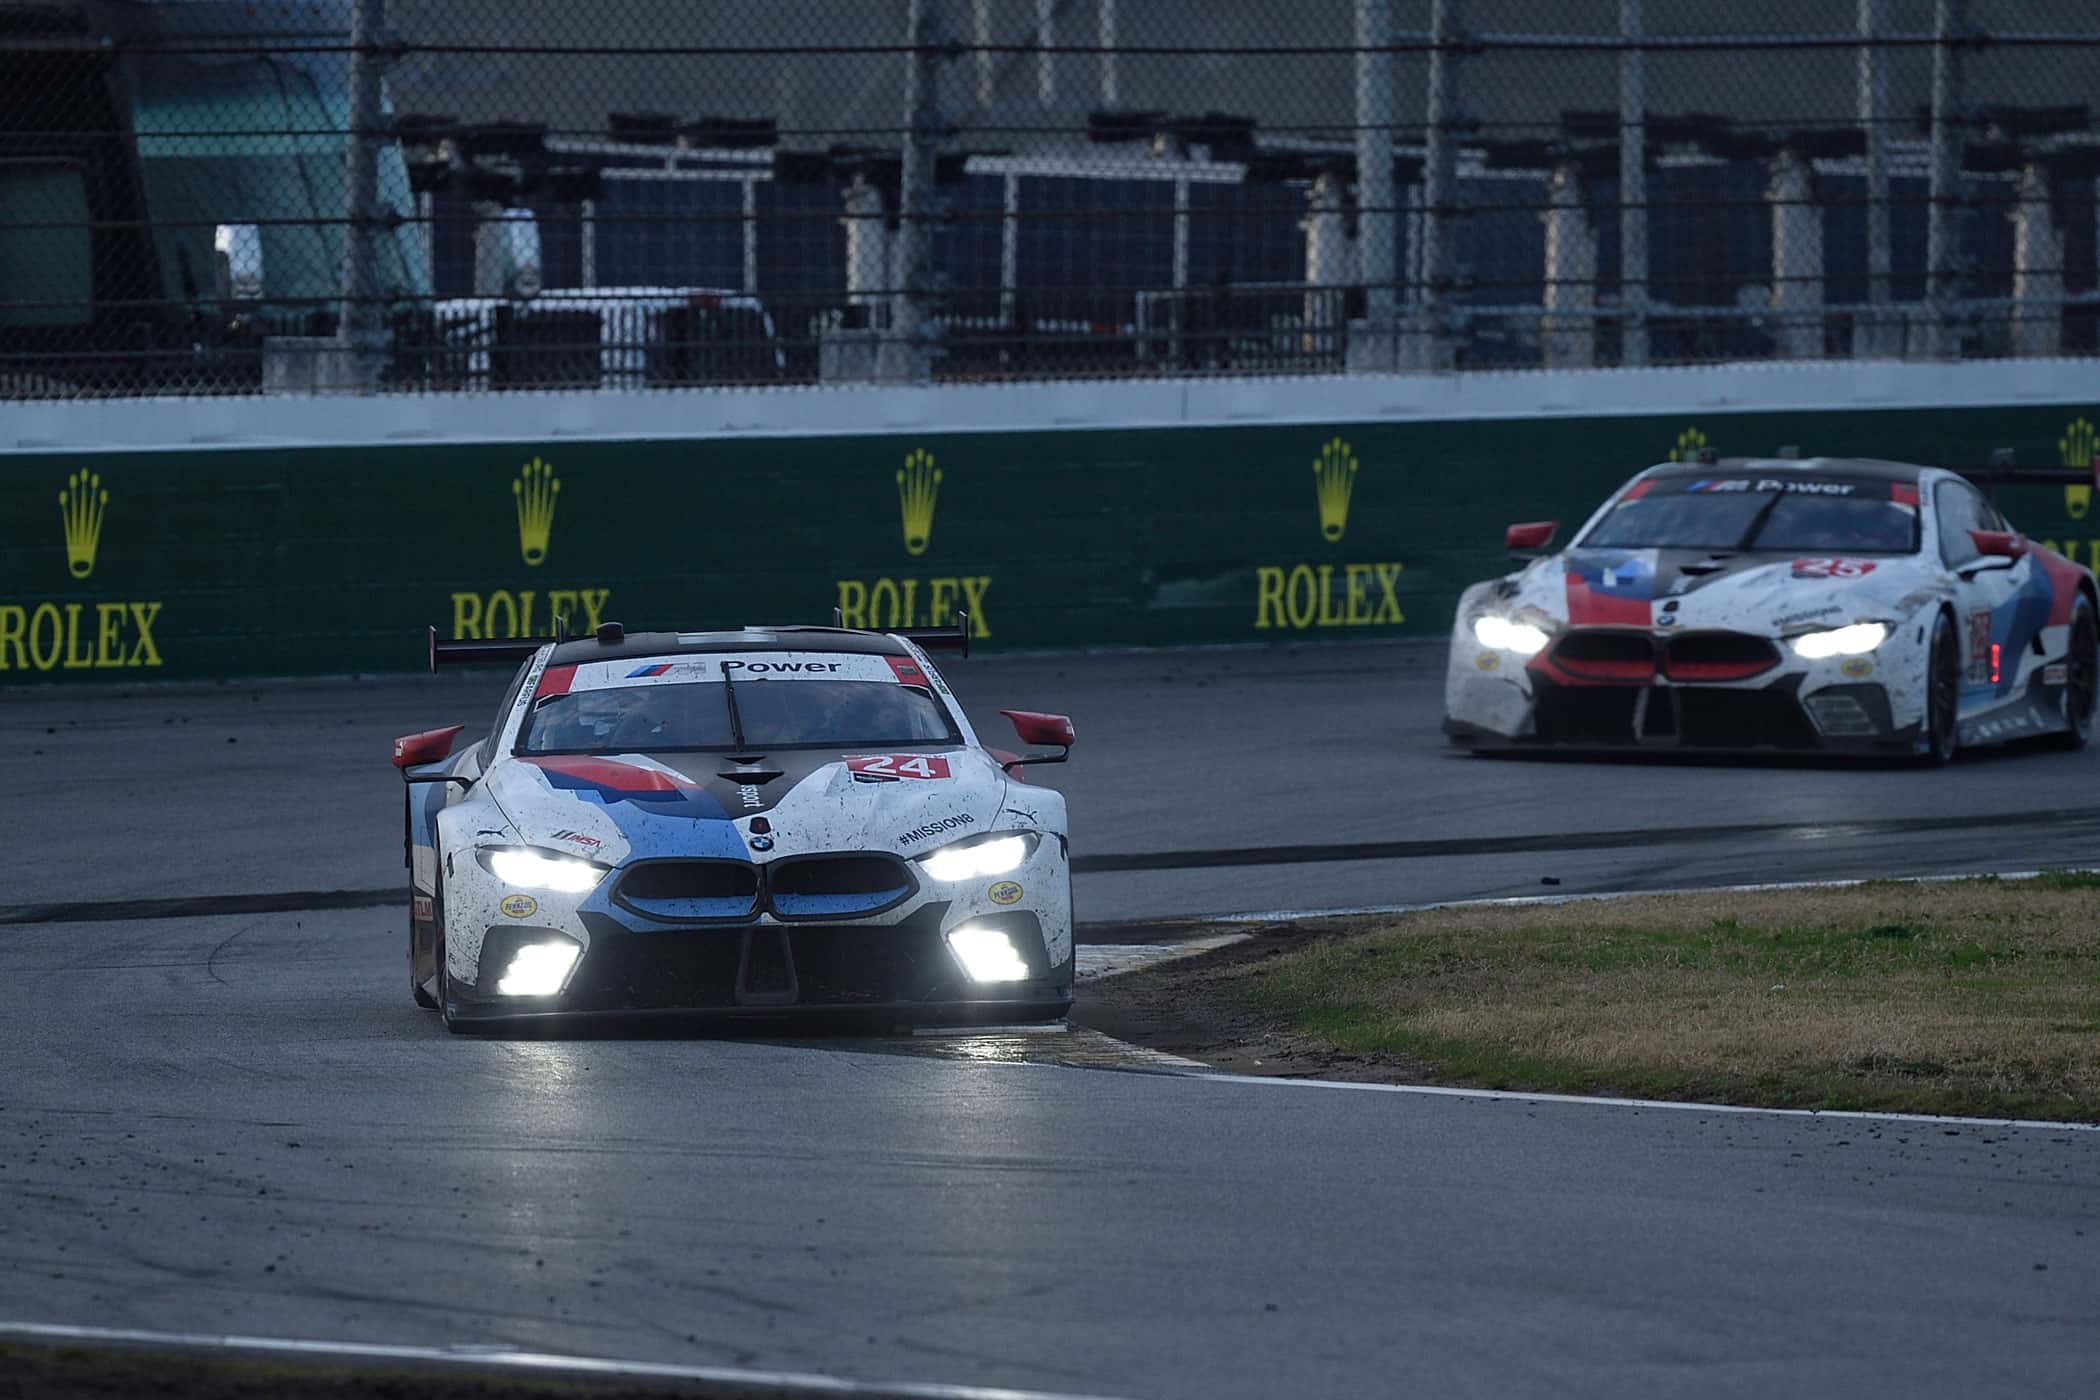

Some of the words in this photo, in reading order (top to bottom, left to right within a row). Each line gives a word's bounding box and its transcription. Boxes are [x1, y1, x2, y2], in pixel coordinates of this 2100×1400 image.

[1756, 479, 1855, 495] Power
[836, 576, 992, 638] ROLEX
[1255, 563, 1405, 629] ROLEX
[0, 602, 163, 670] ROLEX
[720, 660, 842, 674] Power
[862, 756, 937, 778] 24
[899, 813, 975, 846] #MISSION8
